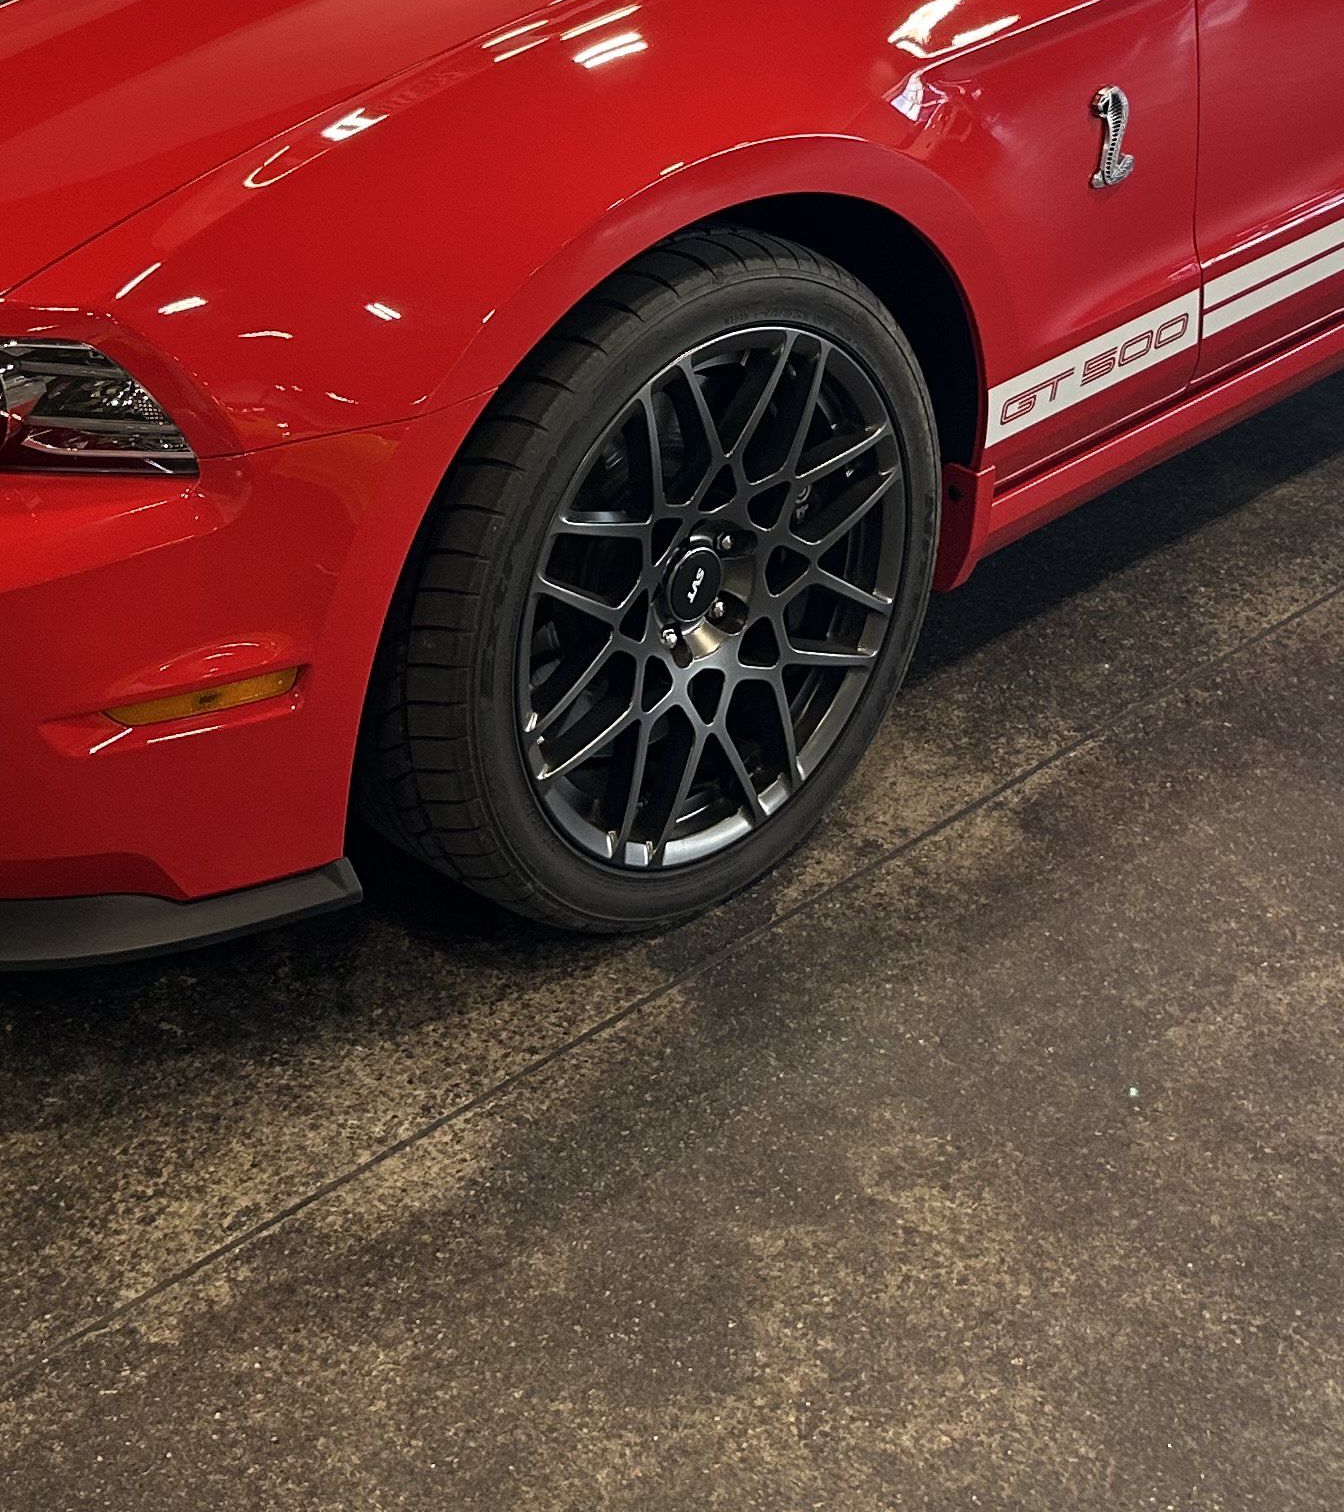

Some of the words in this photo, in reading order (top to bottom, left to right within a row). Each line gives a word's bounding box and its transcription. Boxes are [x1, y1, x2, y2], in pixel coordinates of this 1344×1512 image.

[1000, 367, 1075, 425] GT
[1080, 312, 1189, 386] 500
[687, 567, 705, 604] SVT
